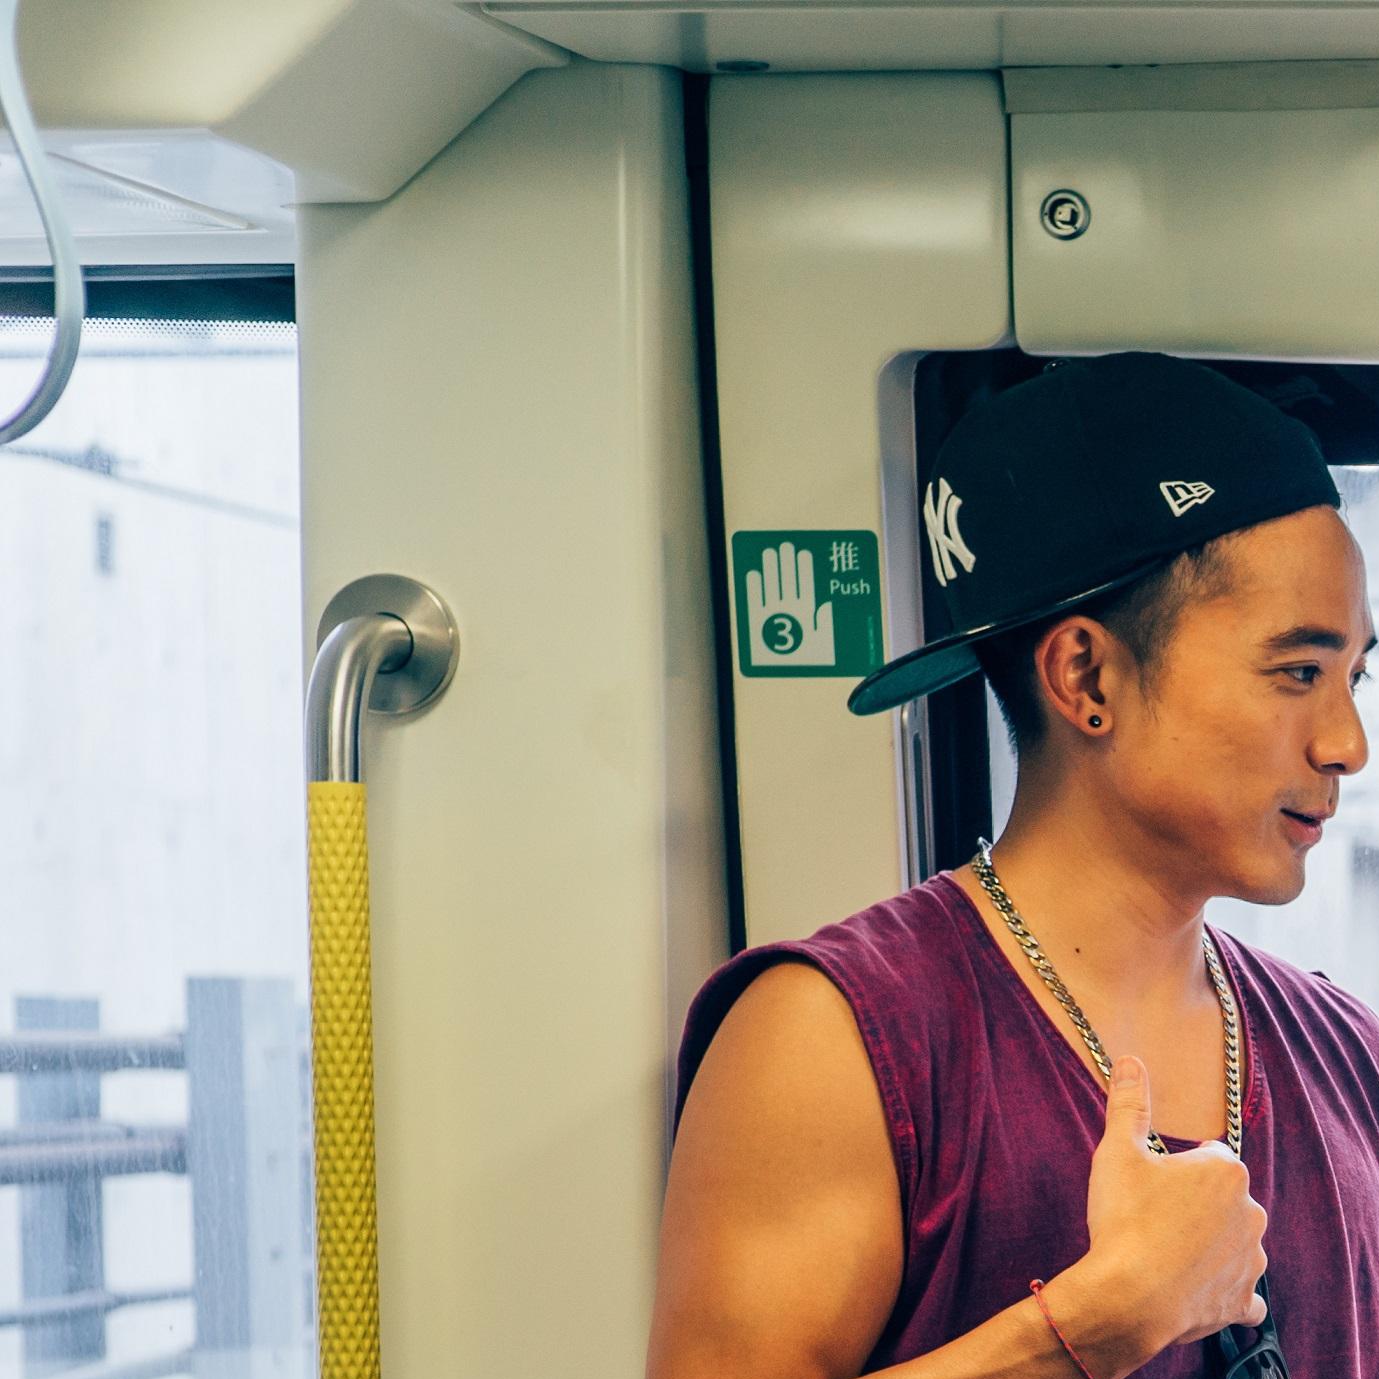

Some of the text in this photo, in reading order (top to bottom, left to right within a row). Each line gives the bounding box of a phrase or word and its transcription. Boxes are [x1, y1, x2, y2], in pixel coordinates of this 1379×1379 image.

[829, 541, 860, 573] 推
[829, 579, 871, 595] Push
[773, 617, 795, 651] 3
